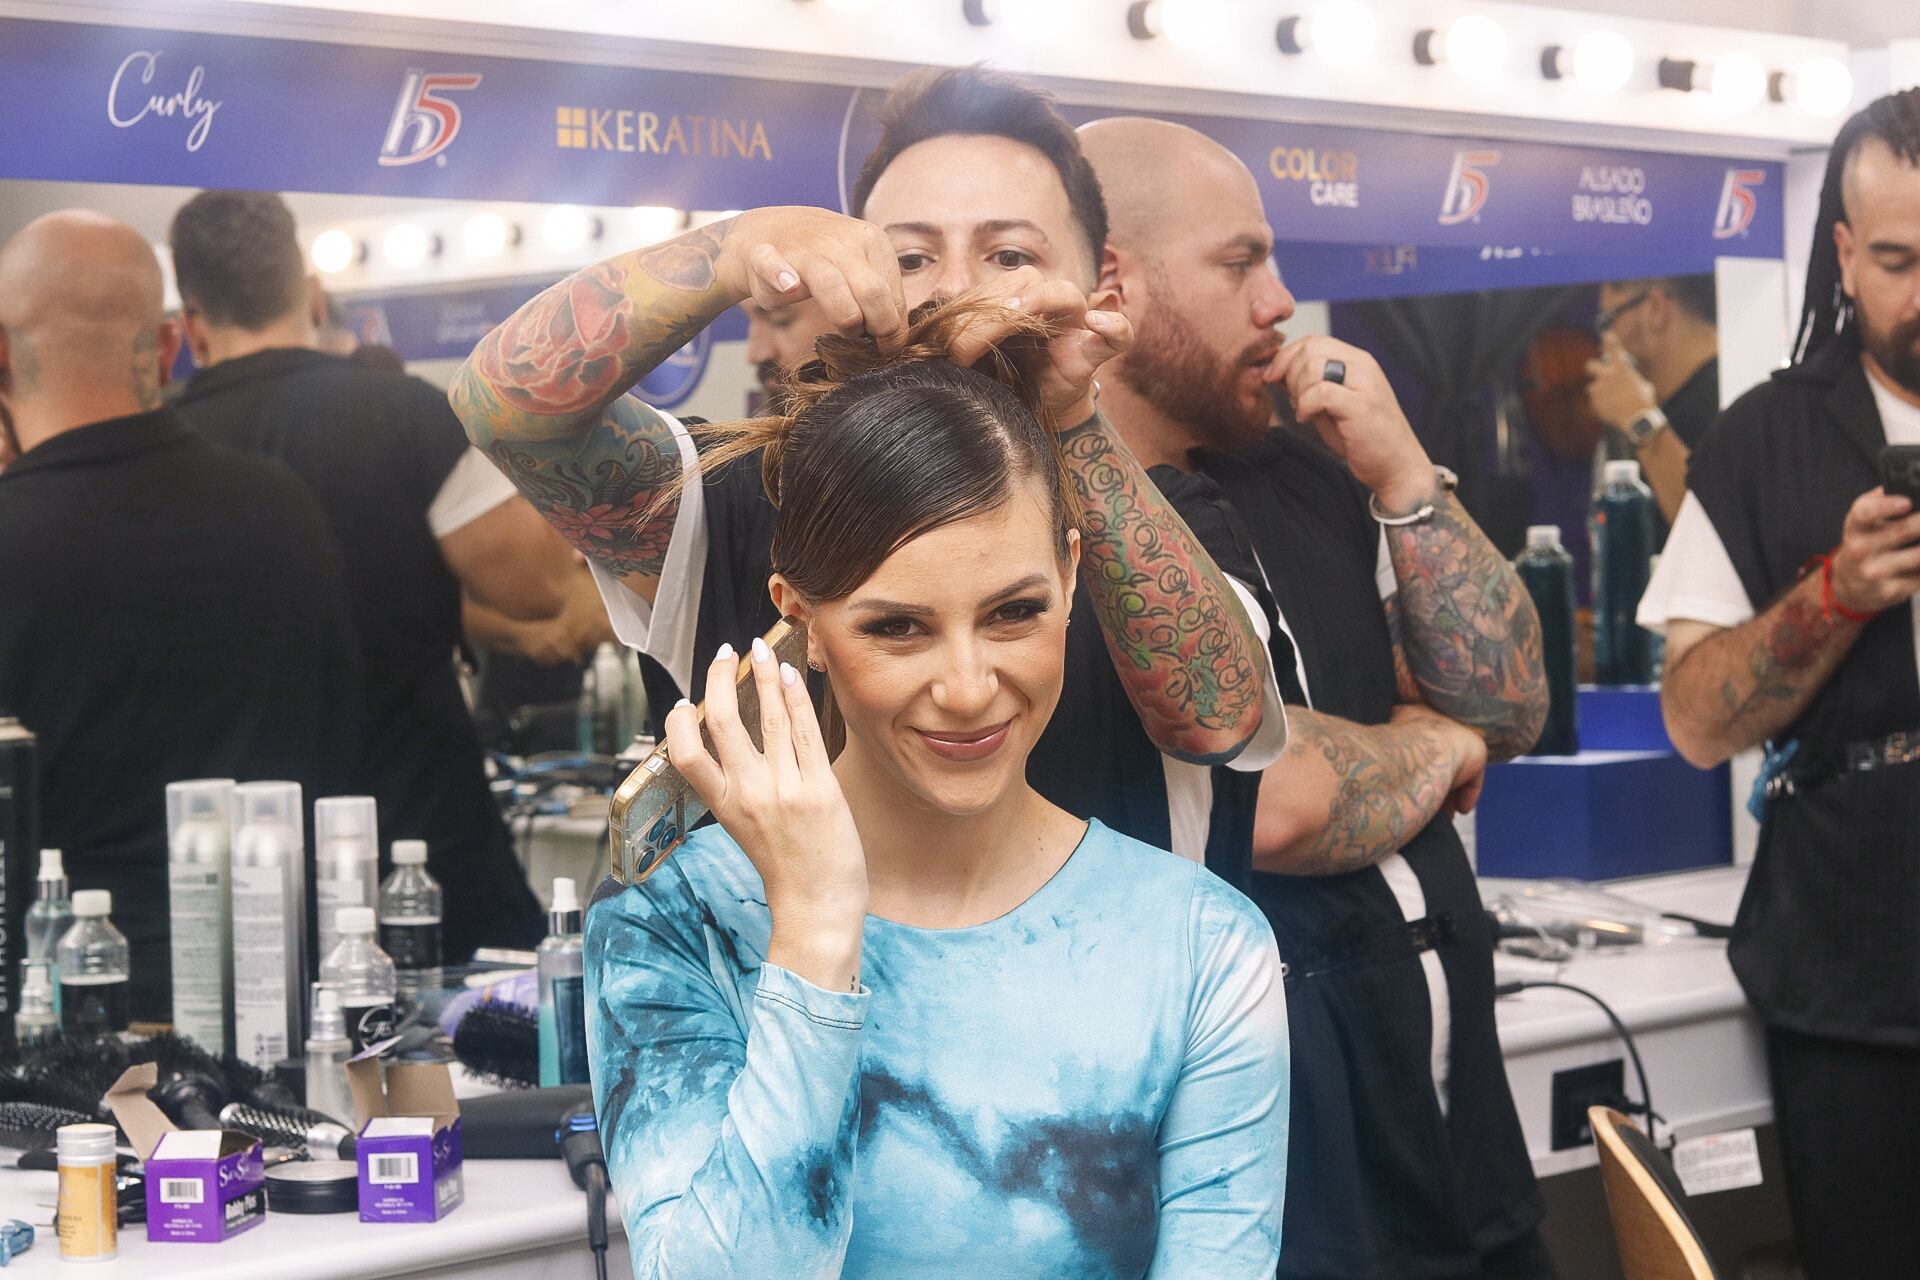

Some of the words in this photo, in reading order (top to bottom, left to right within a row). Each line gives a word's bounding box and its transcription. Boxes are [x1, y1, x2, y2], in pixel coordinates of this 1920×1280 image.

[108, 50, 223, 152] Curly
[592, 109, 773, 161] KERATINA
[1269, 147, 1358, 182] COLOR
[1310, 181, 1359, 208] CARE
